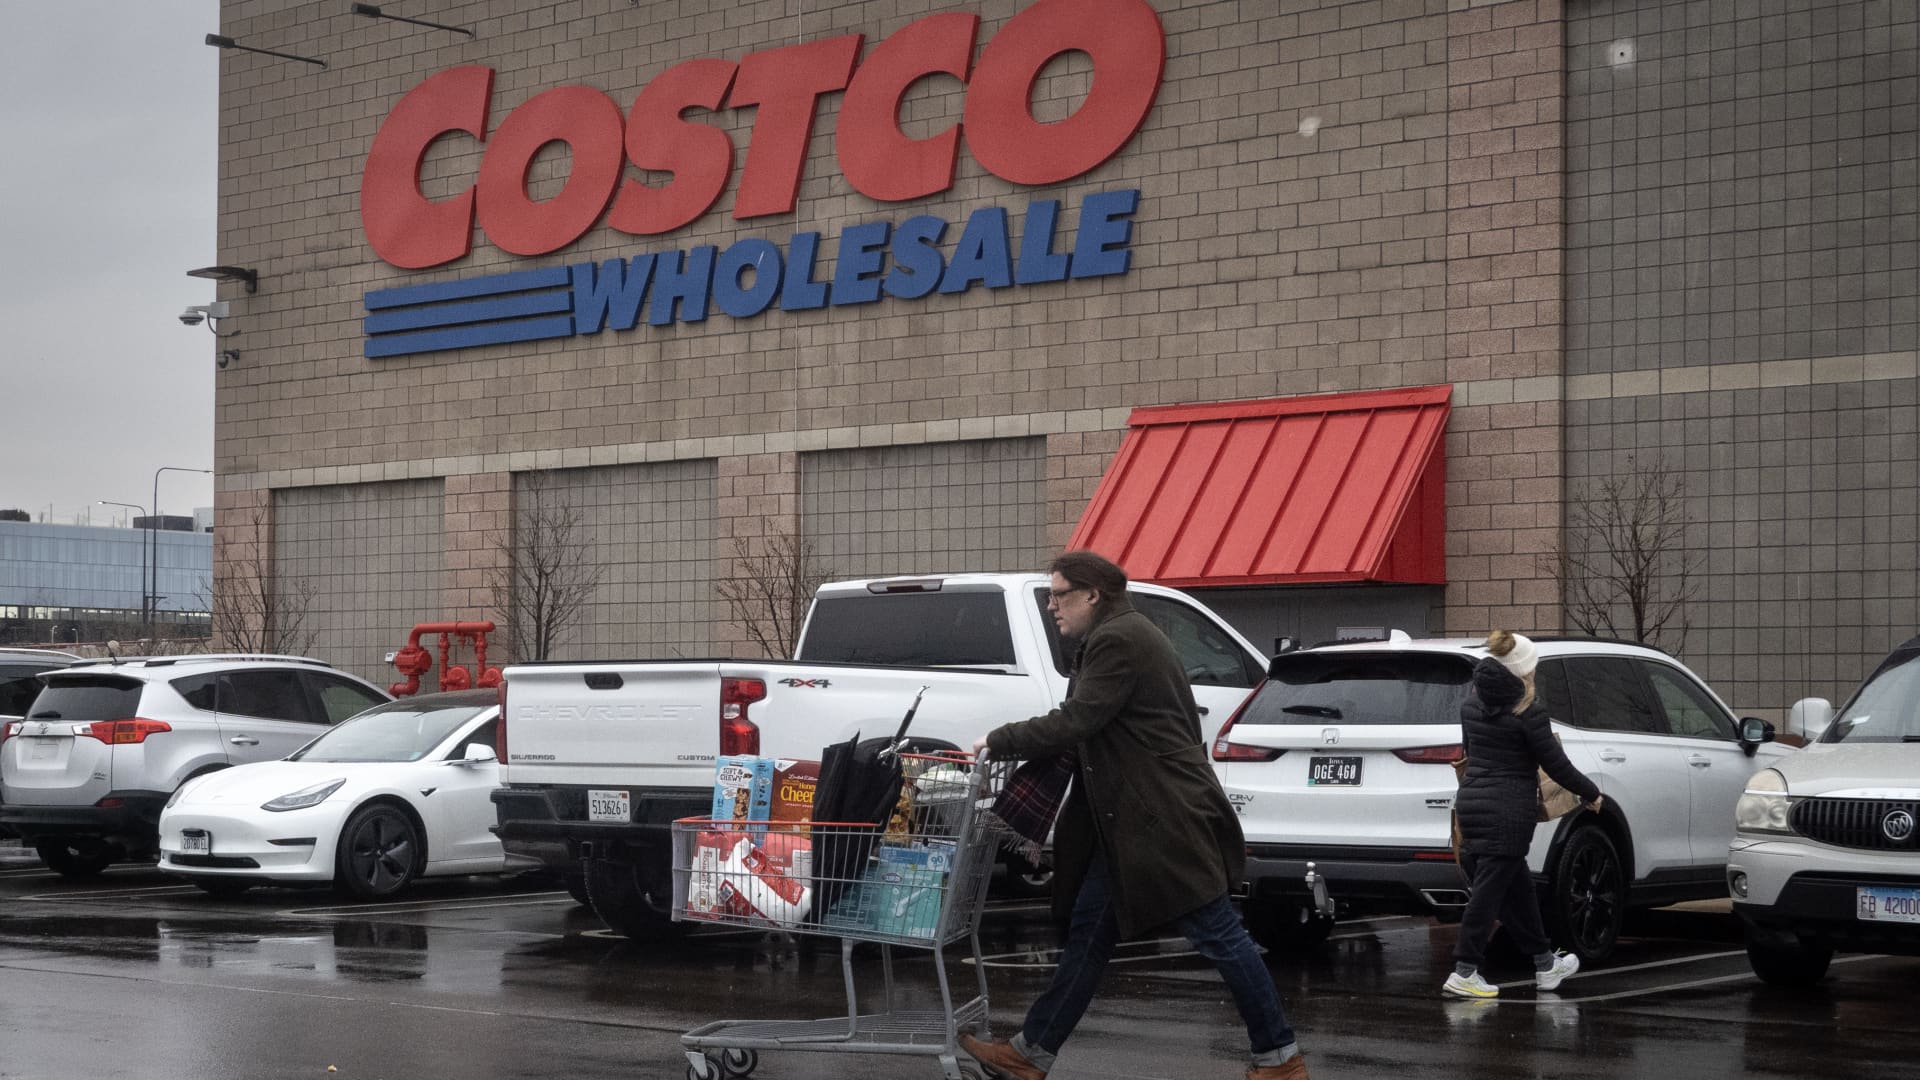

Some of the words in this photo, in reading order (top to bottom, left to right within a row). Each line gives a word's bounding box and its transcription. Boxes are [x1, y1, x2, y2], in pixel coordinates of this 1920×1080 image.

[360, 0, 1166, 269] COSTCO
[571, 188, 1140, 335] WHOLESALE
[518, 704, 702, 721] CHEVROLET
[720, 774, 742, 783] CHEWY
[1229, 793, 1254, 802] CR-V
[592, 799, 621, 815] 513626
[1860, 895, 1876, 913] FB
